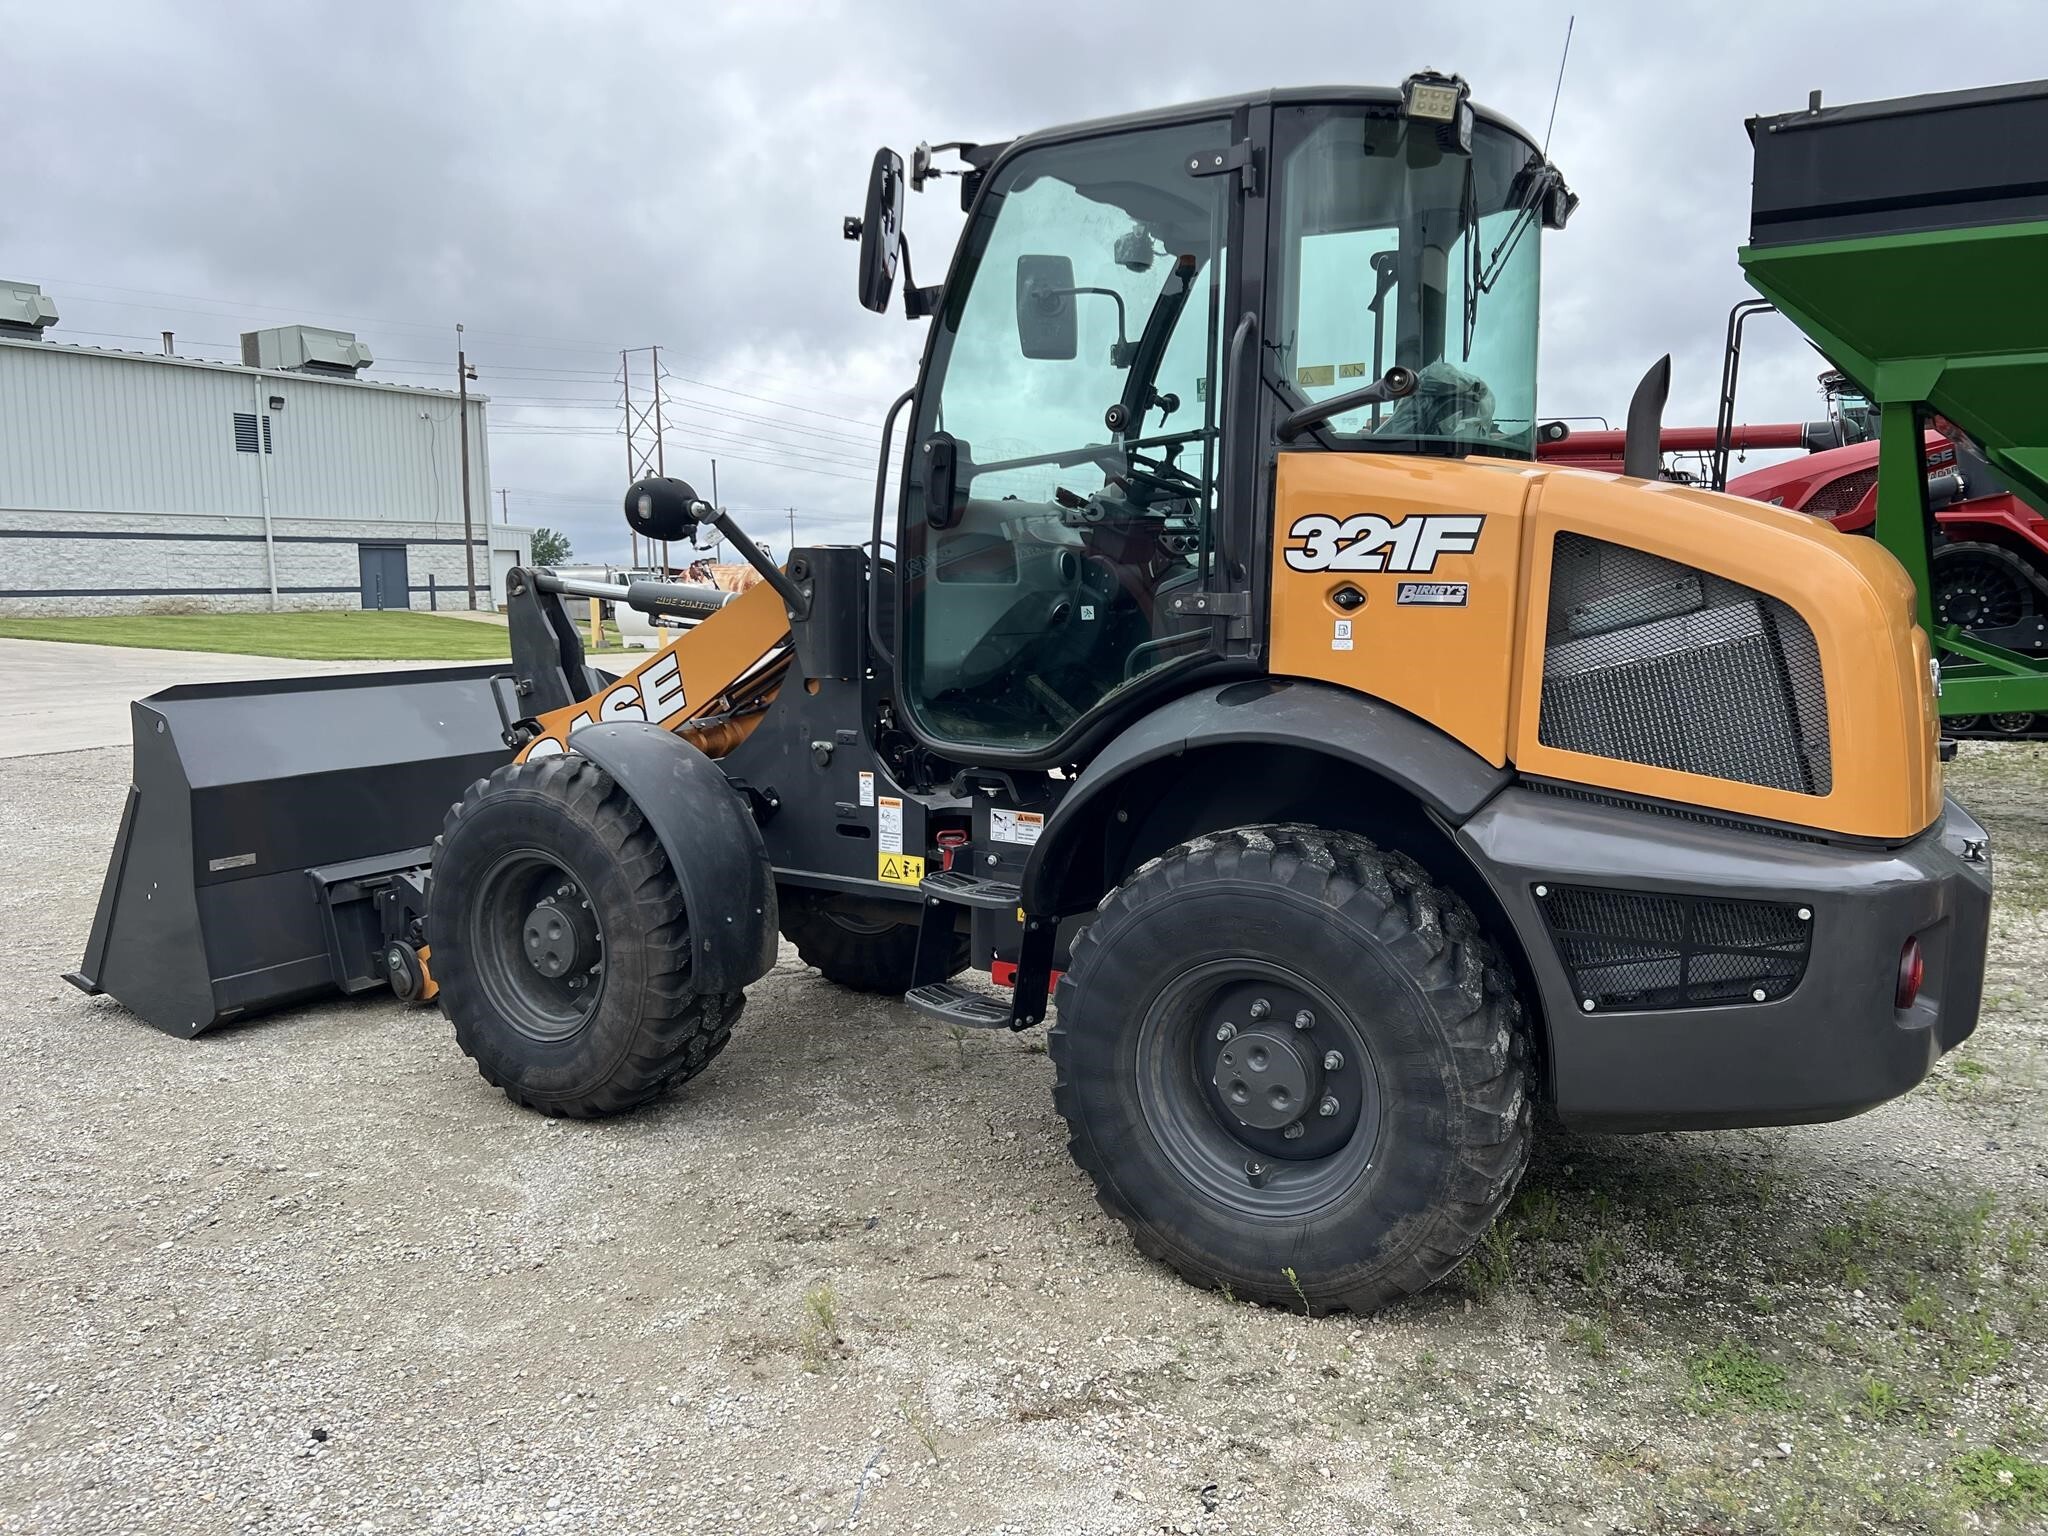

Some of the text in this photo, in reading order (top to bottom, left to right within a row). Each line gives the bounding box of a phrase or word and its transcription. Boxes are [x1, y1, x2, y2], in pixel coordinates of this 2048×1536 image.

[1926, 448, 1953, 467] SE
[1283, 513, 1487, 574] 321F
[655, 596, 678, 606] RIDE
[1398, 584, 1467, 604] BIRKEY'S
